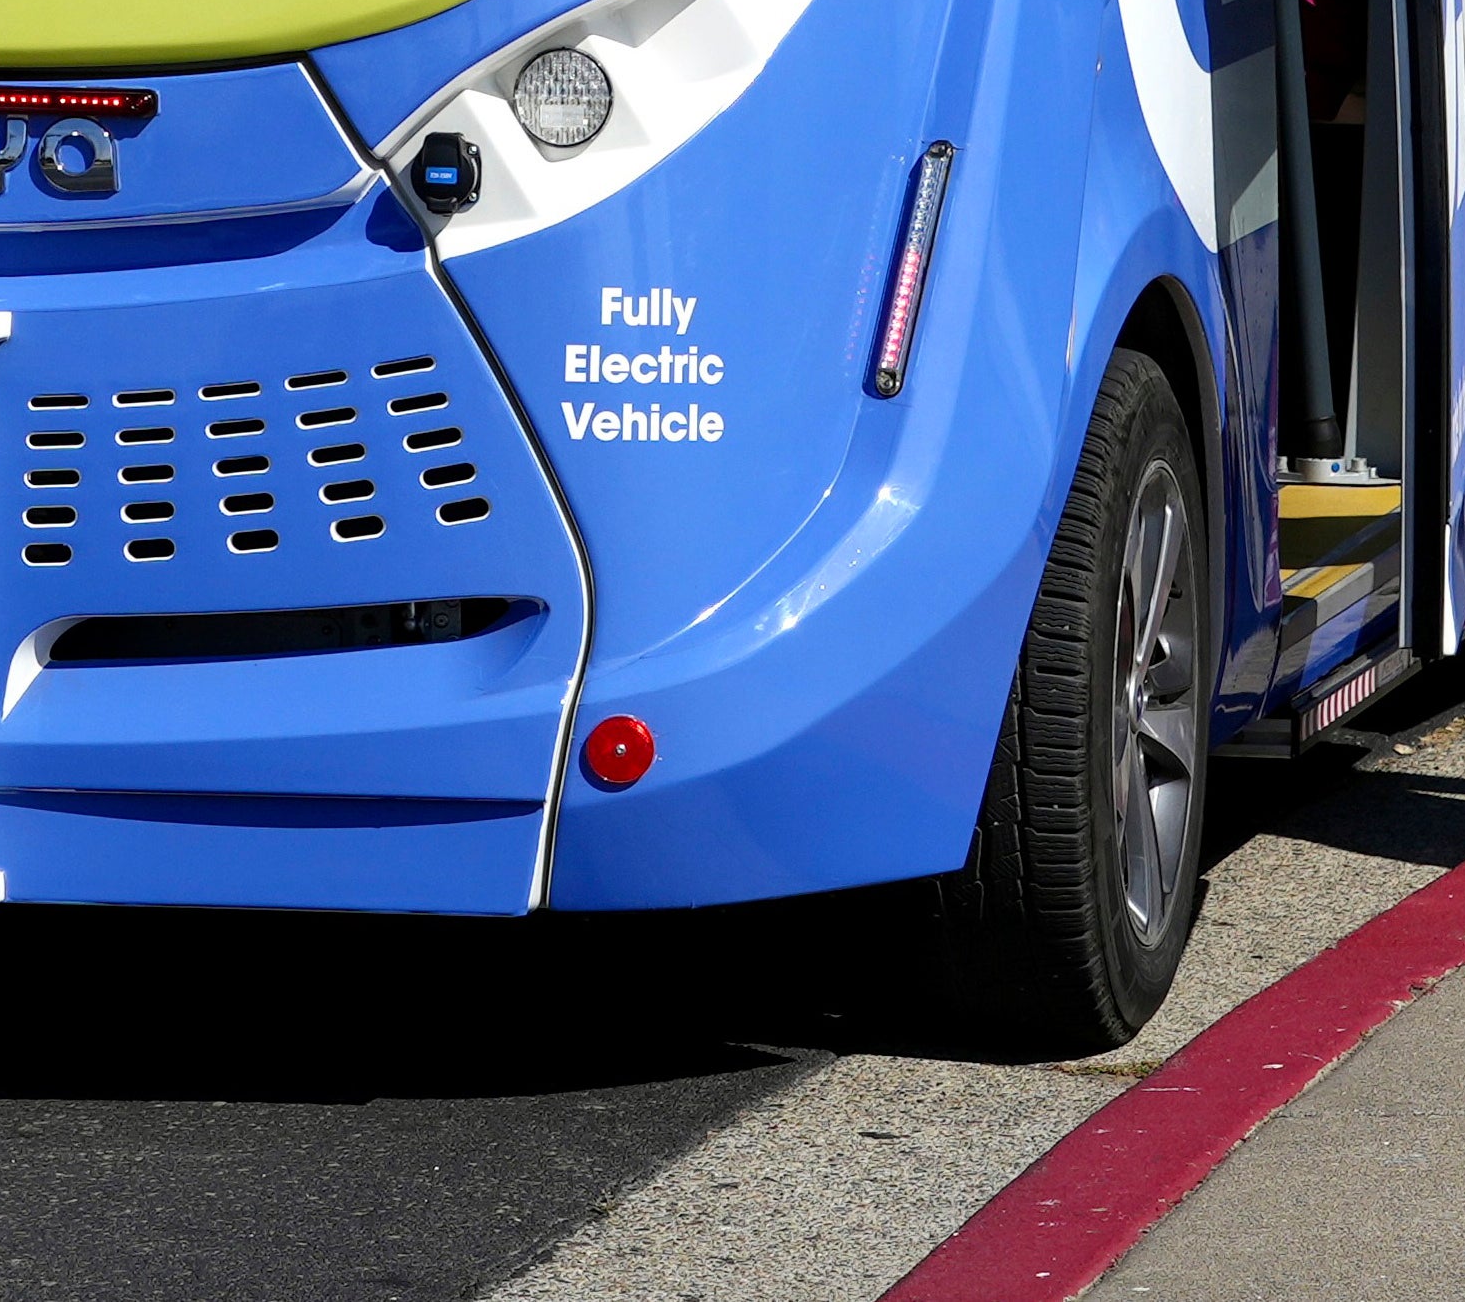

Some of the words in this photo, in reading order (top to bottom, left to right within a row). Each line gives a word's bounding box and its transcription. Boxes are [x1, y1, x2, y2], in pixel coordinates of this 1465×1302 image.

[600, 286, 698, 336] Fully
[564, 343, 725, 386] Electric
[560, 401, 725, 443] Vehicle
